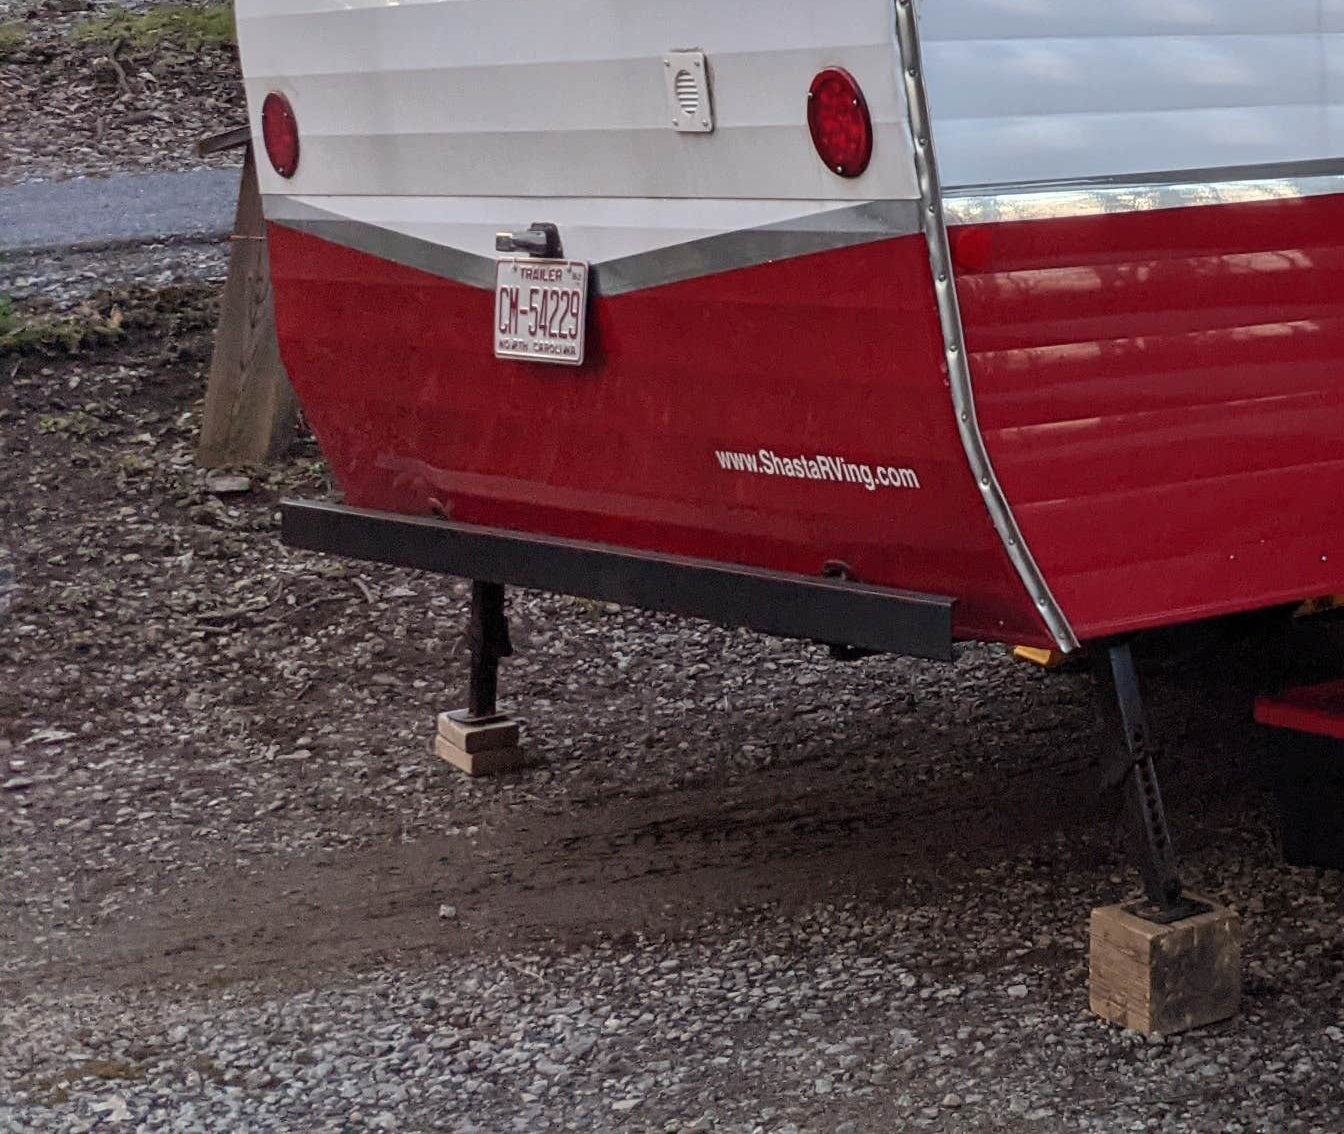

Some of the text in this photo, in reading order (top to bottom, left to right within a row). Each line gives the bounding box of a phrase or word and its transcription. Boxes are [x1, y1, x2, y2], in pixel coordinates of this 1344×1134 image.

[520, 267, 562, 281] TRAILER
[500, 287, 580, 340] CM-54229
[499, 338, 577, 355] NORTH CAROLINA
[715, 449, 920, 490] www.ShastaRVing.com
